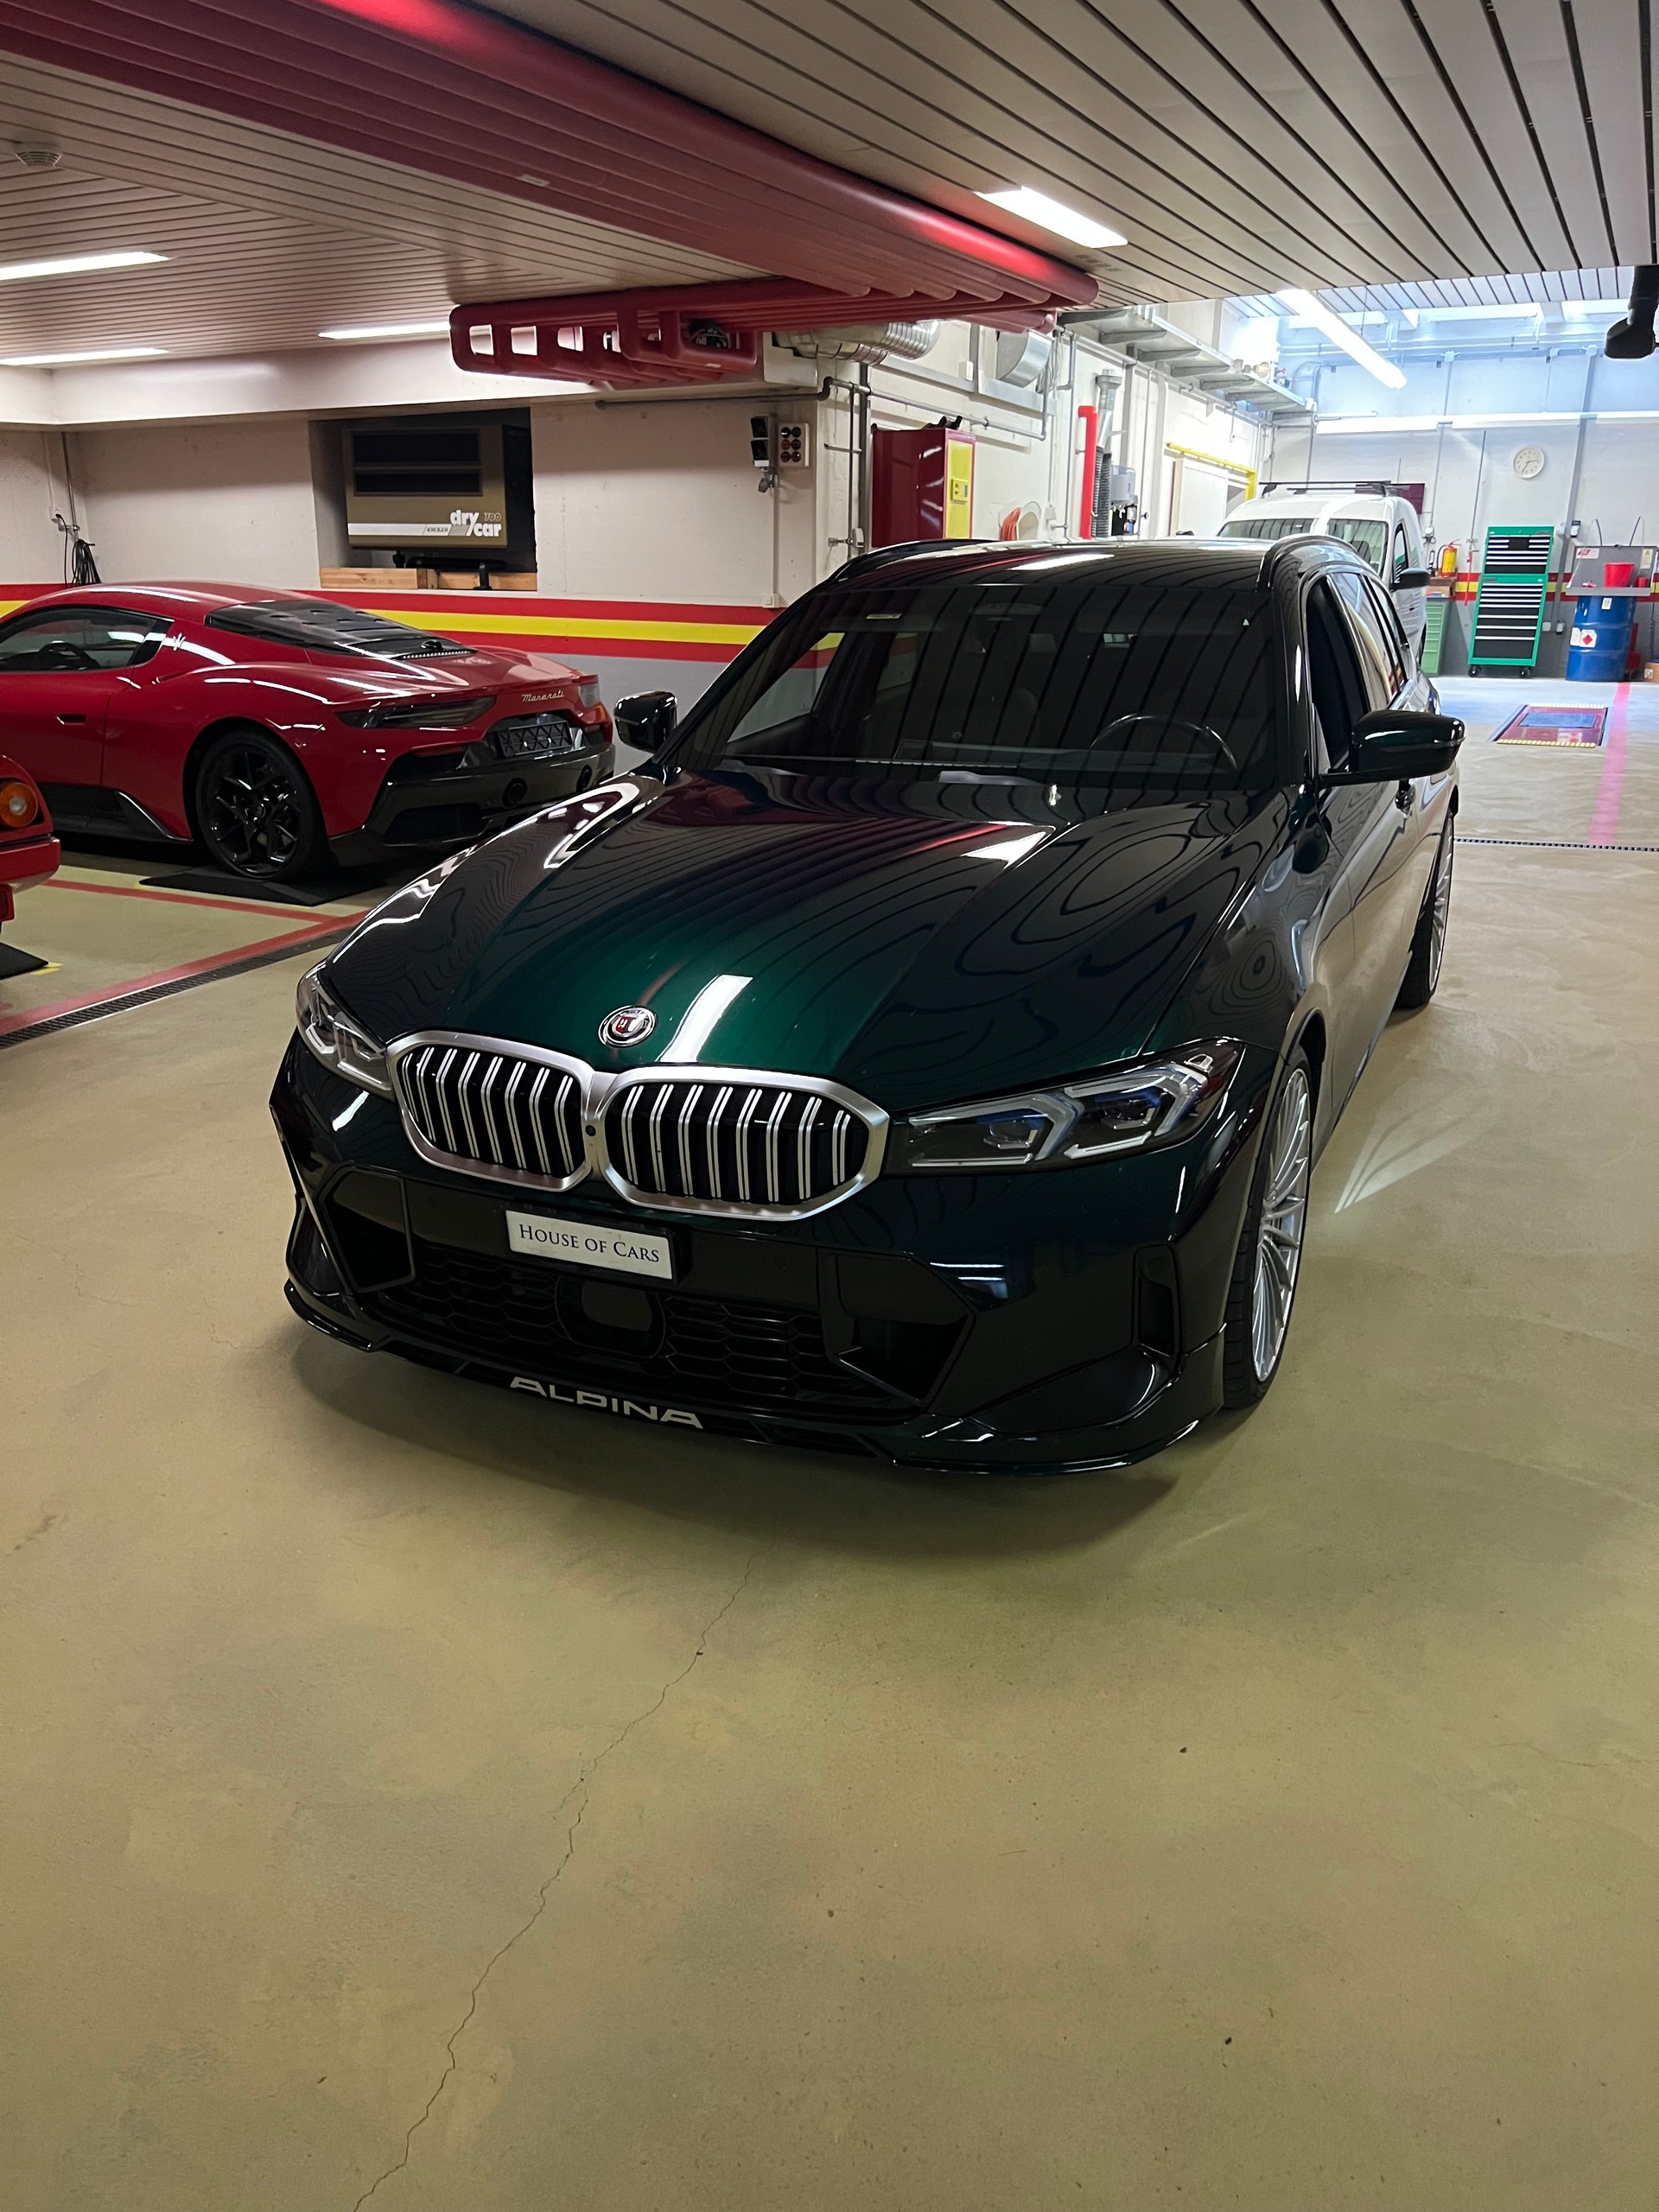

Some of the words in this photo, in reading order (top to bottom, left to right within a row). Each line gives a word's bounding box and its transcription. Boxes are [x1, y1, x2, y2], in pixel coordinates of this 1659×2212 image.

[450, 510, 479, 537] dry
[484, 512, 501, 521] 700
[474, 523, 502, 537] car
[521, 690, 564, 702] Maserati
[518, 1224, 580, 1249] HOUSE
[584, 1237, 607, 1253] OF
[613, 1241, 659, 1263] CARS
[510, 1376, 704, 1429] ALPINA
